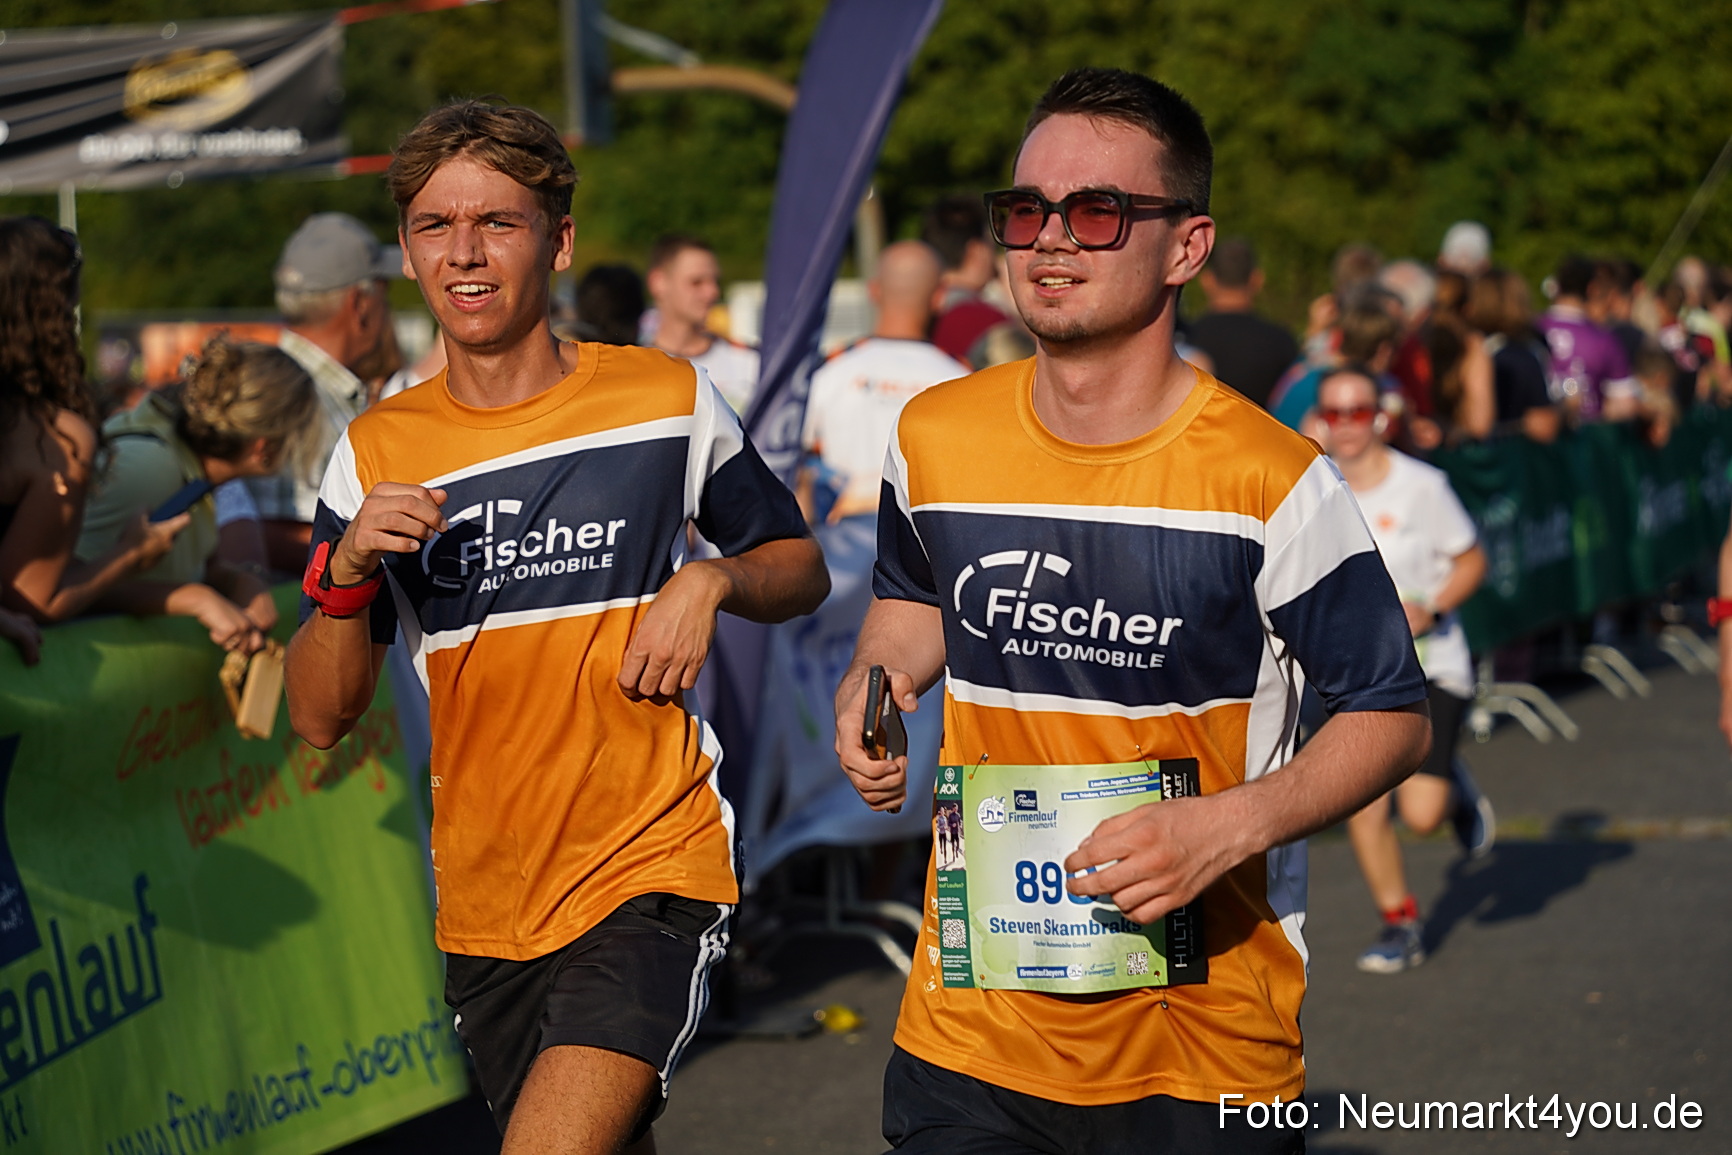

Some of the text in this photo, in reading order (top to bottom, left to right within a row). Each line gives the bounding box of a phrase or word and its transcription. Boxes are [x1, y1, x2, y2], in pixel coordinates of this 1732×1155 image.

[460, 517, 626, 577] Fischer
[986, 587, 1184, 646] Fischer
[1001, 637, 1166, 670] AUTOMOBILE
[939, 783, 959, 795] AOK
[1162, 772, 1173, 801] ATT
[1174, 773, 1183, 799] TLET
[1008, 810, 1058, 823] Firmenlauf
[1028, 821, 1057, 830] neumarkt
[989, 917, 1142, 936] Steven Skambraks
